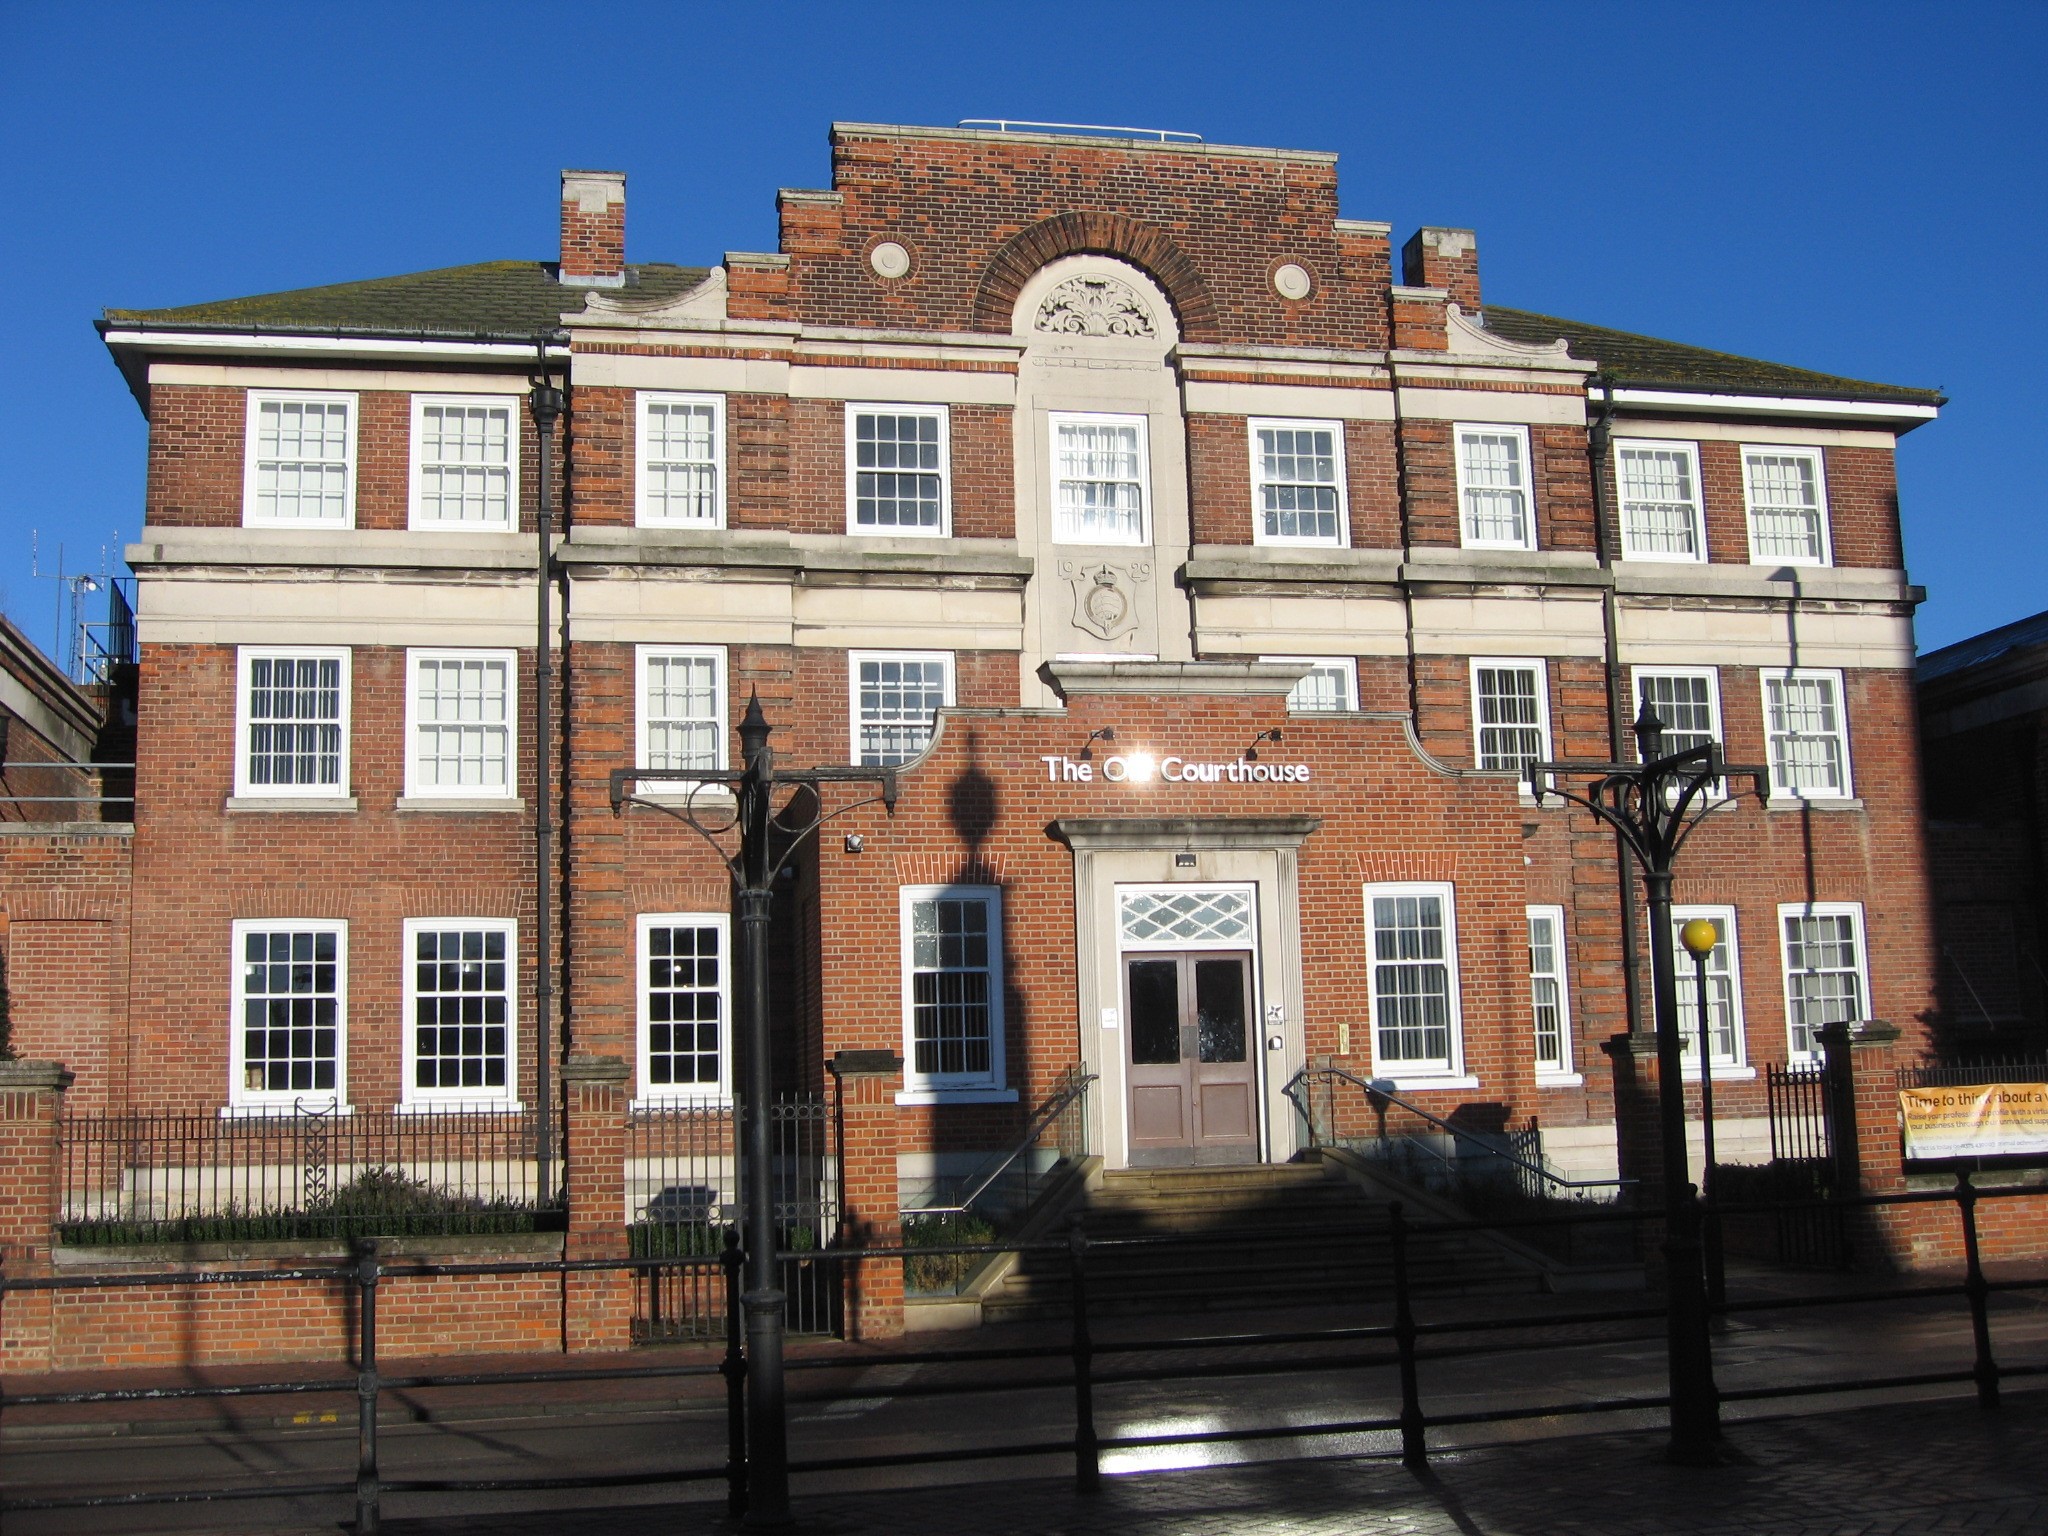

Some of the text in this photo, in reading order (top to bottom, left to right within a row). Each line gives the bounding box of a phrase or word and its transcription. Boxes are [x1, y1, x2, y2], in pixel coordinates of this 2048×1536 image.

[1057, 559, 1151, 582] 19 29
[1041, 756, 1093, 782] The
[1160, 756, 1311, 783] Courthouse
[1906, 1095, 1940, 1108] Time
[1942, 1095, 1955, 1107] to
[1957, 1092, 1991, 1106] thik
[2034, 1093, 2043, 1103] a
[1907, 1112, 1927, 1120] Raise
[1927, 1113, 1941, 1121] your
[1924, 1121, 1955, 1130] business
